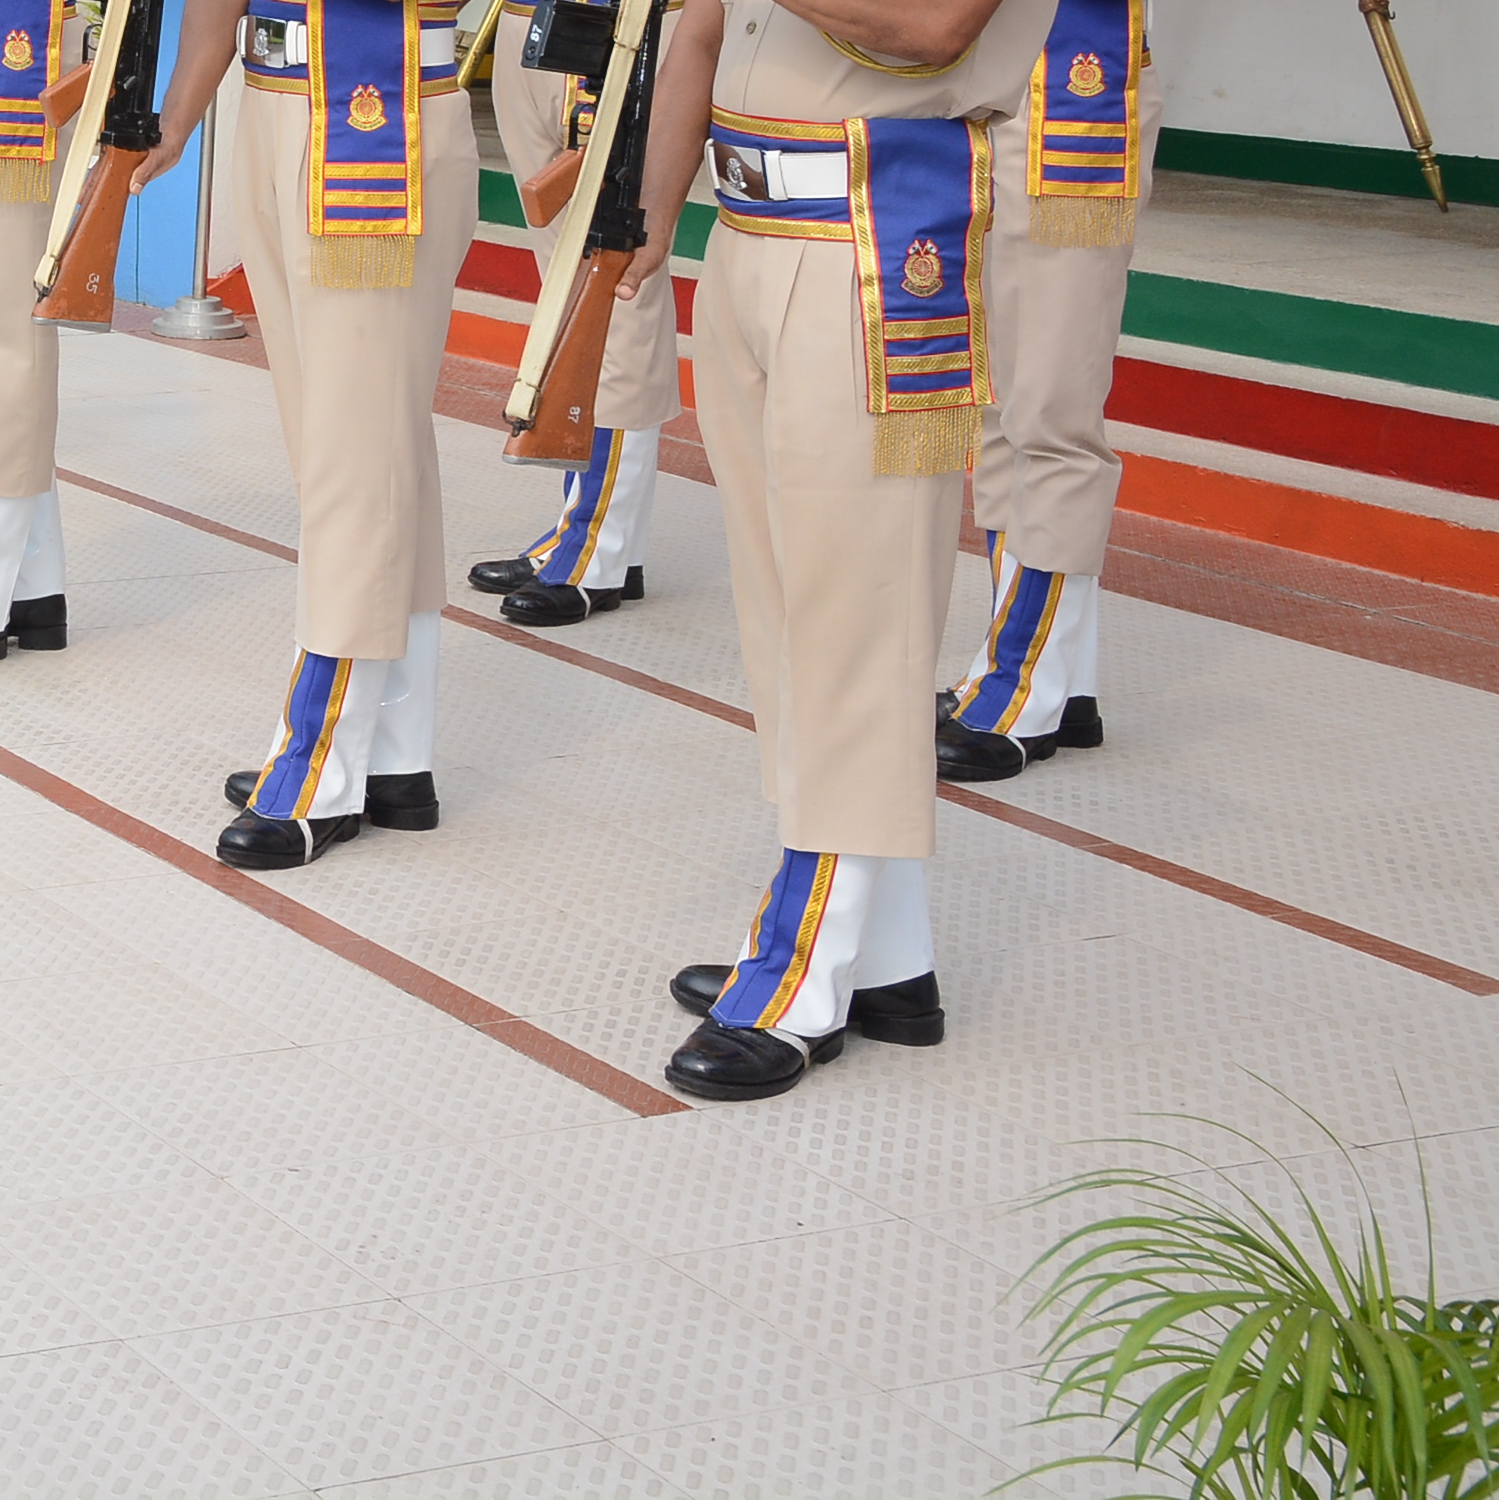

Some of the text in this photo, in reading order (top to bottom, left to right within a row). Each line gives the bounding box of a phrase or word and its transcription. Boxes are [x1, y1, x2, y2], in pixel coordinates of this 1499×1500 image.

[530, 24, 542, 42] 87
[86, 272, 100, 295] 35
[568, 406, 581, 424] 87
